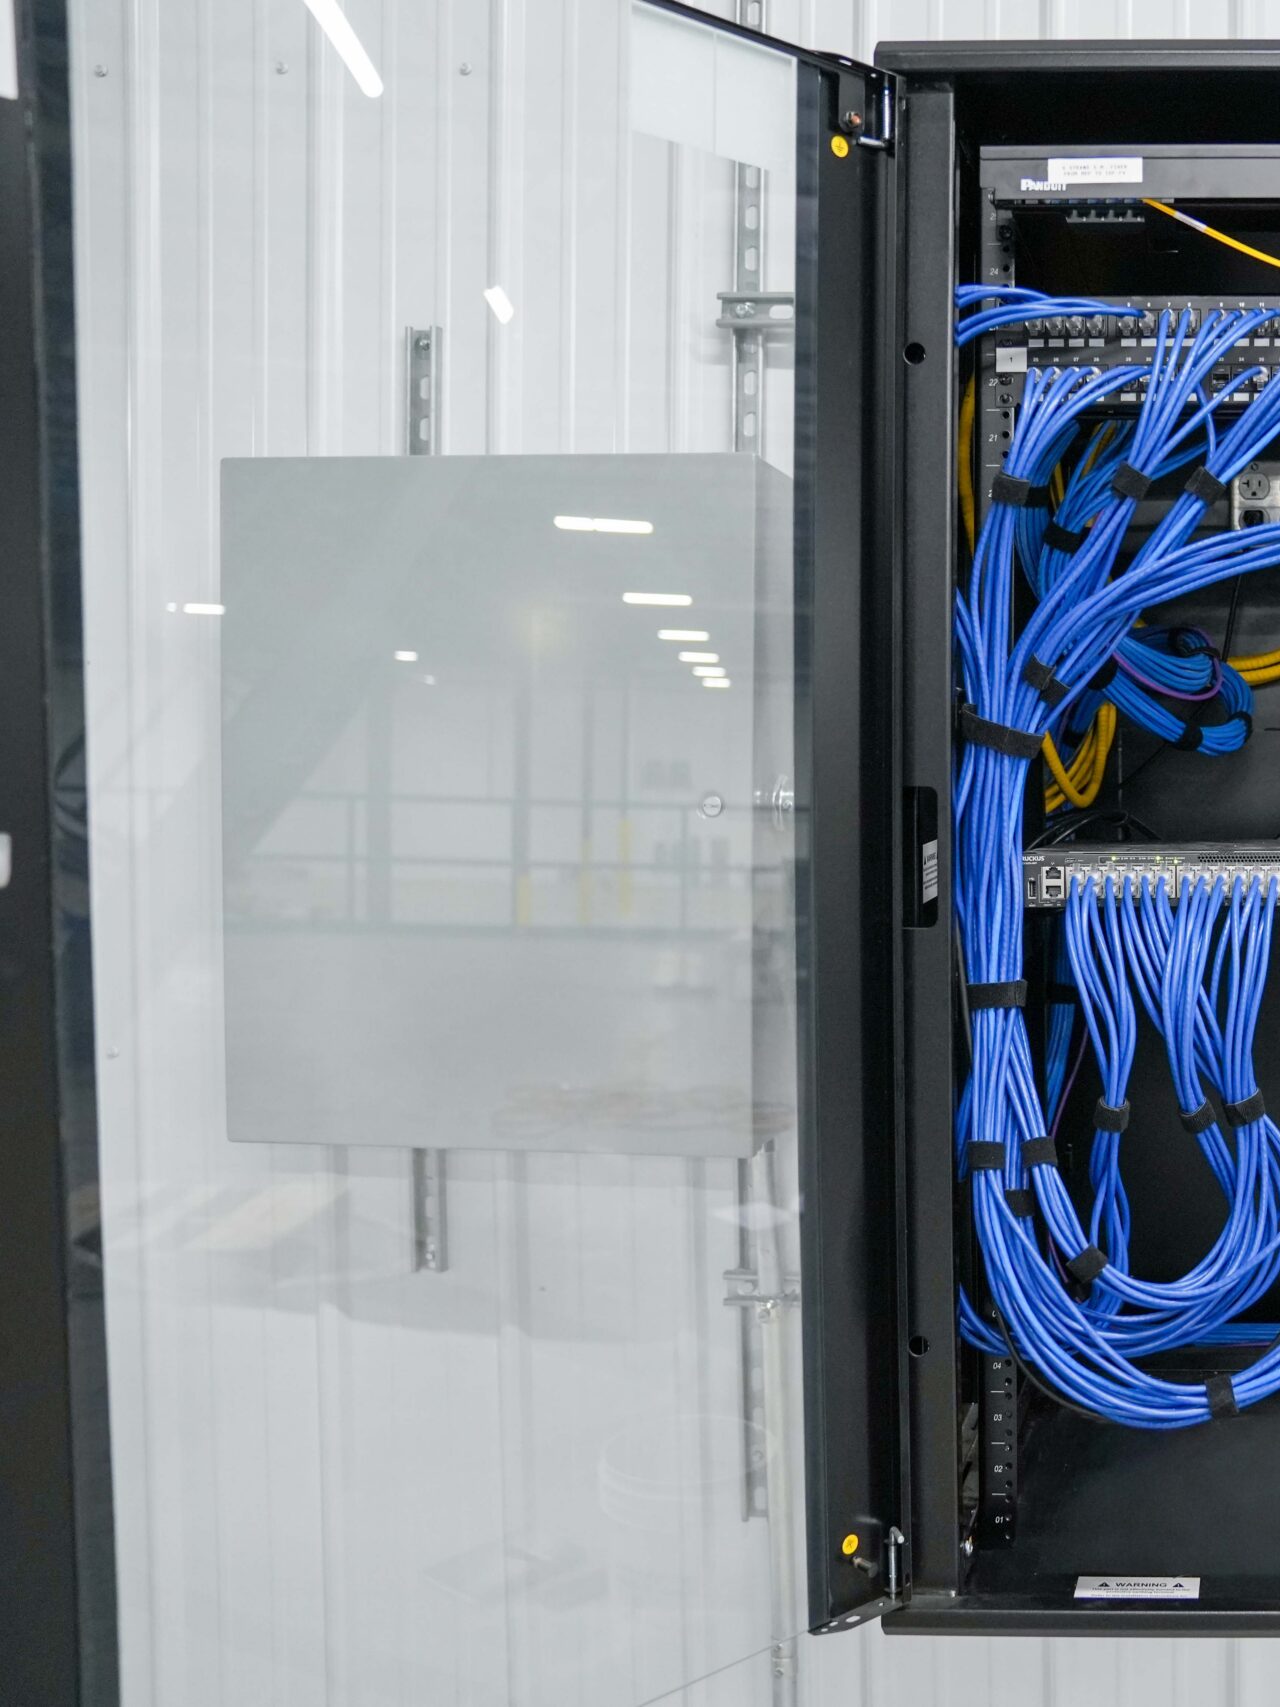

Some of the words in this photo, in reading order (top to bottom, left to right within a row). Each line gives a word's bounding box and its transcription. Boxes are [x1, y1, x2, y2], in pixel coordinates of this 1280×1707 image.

[990, 268, 998, 276] 24
[988, 378, 998, 386] 22
[988, 434, 998, 442] 21
